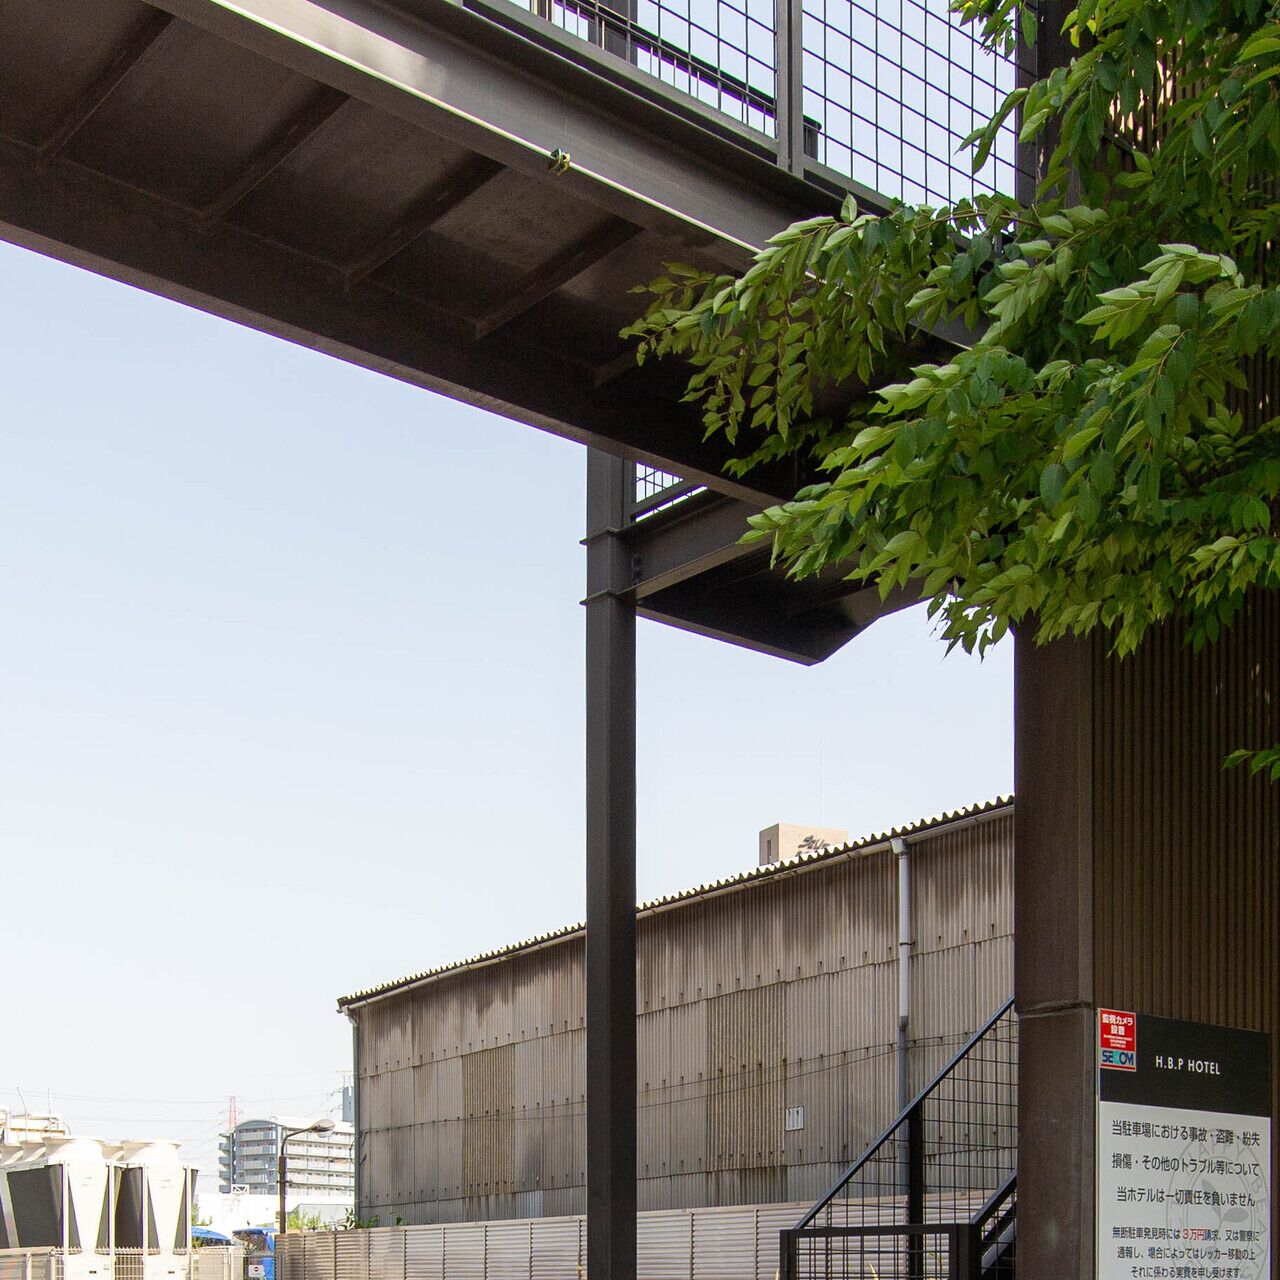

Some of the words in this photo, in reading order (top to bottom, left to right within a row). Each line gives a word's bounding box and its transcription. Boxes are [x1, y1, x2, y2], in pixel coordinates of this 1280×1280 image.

[1102, 1050, 1134, 1065] SECOM
[1155, 1055, 1184, 1070] H.B.P
[1187, 1059, 1220, 1075] HOTEL
[1111, 1152, 1260, 1177] 損傷・その他のトラブル等について
[1117, 1186, 1256, 1207] 当ホテルは一切責任を負いません
